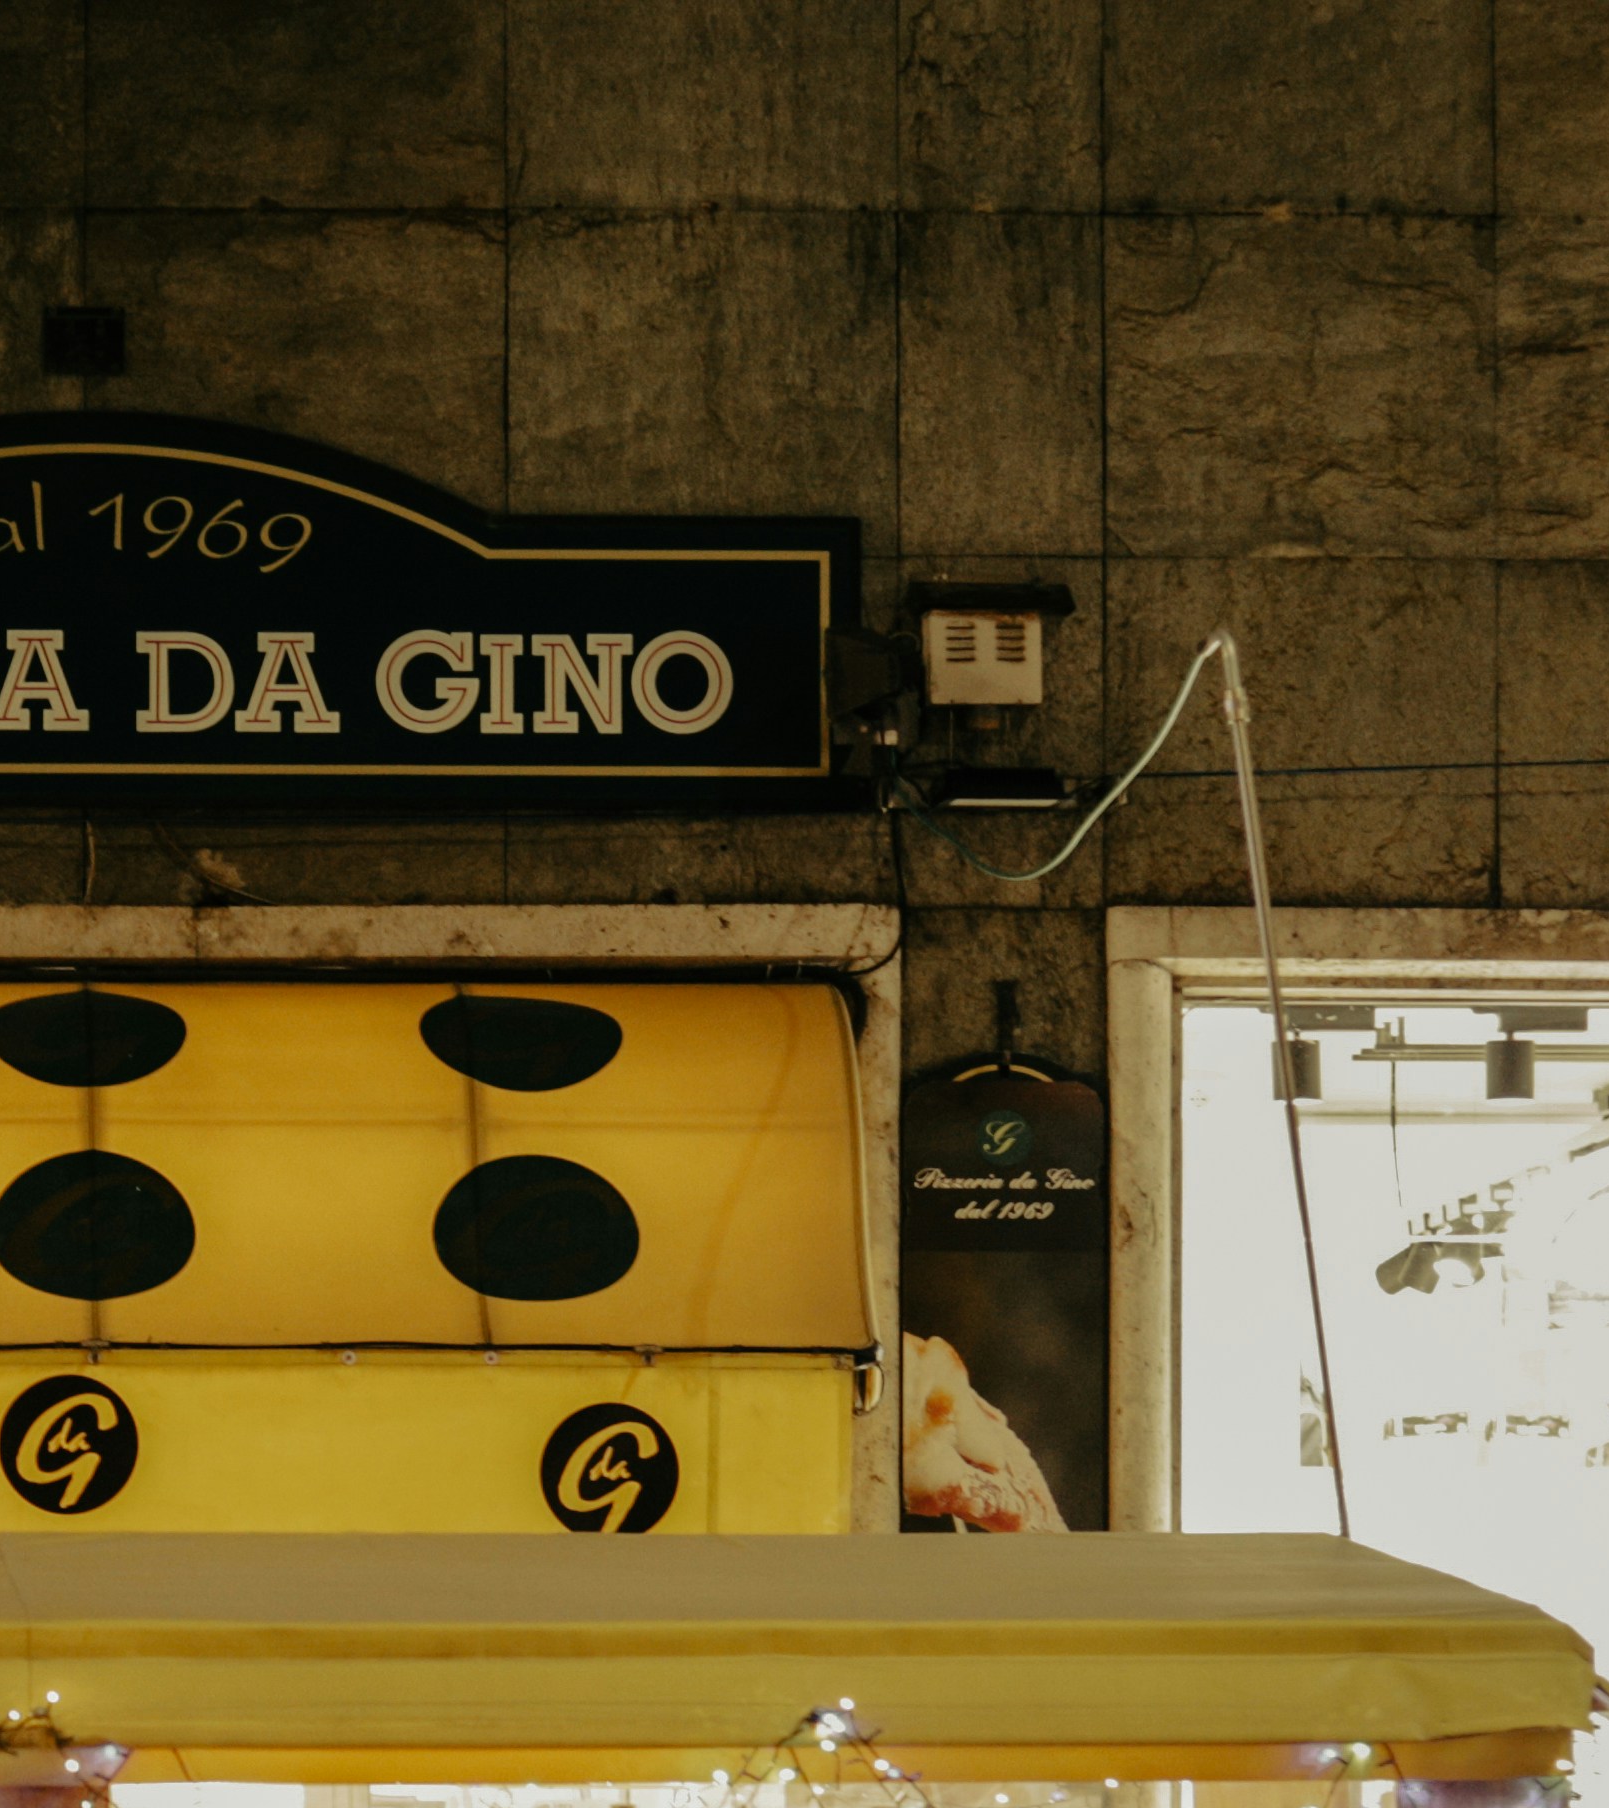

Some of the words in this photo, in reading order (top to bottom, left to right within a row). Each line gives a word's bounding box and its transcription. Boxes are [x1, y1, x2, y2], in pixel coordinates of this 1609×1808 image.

[89, 493, 313, 574] 1969
[135, 630, 341, 734] DA
[375, 629, 734, 735] GINO
[914, 1167, 1004, 1189] Pizzeria
[1009, 1171, 1038, 1190] da
[1044, 1168, 1096, 1190] Gino
[954, 1199, 1000, 1220] dal
[996, 1201, 1055, 1220] 1969
[47, 1416, 91, 1453] da
[588, 1445, 632, 1481] da
